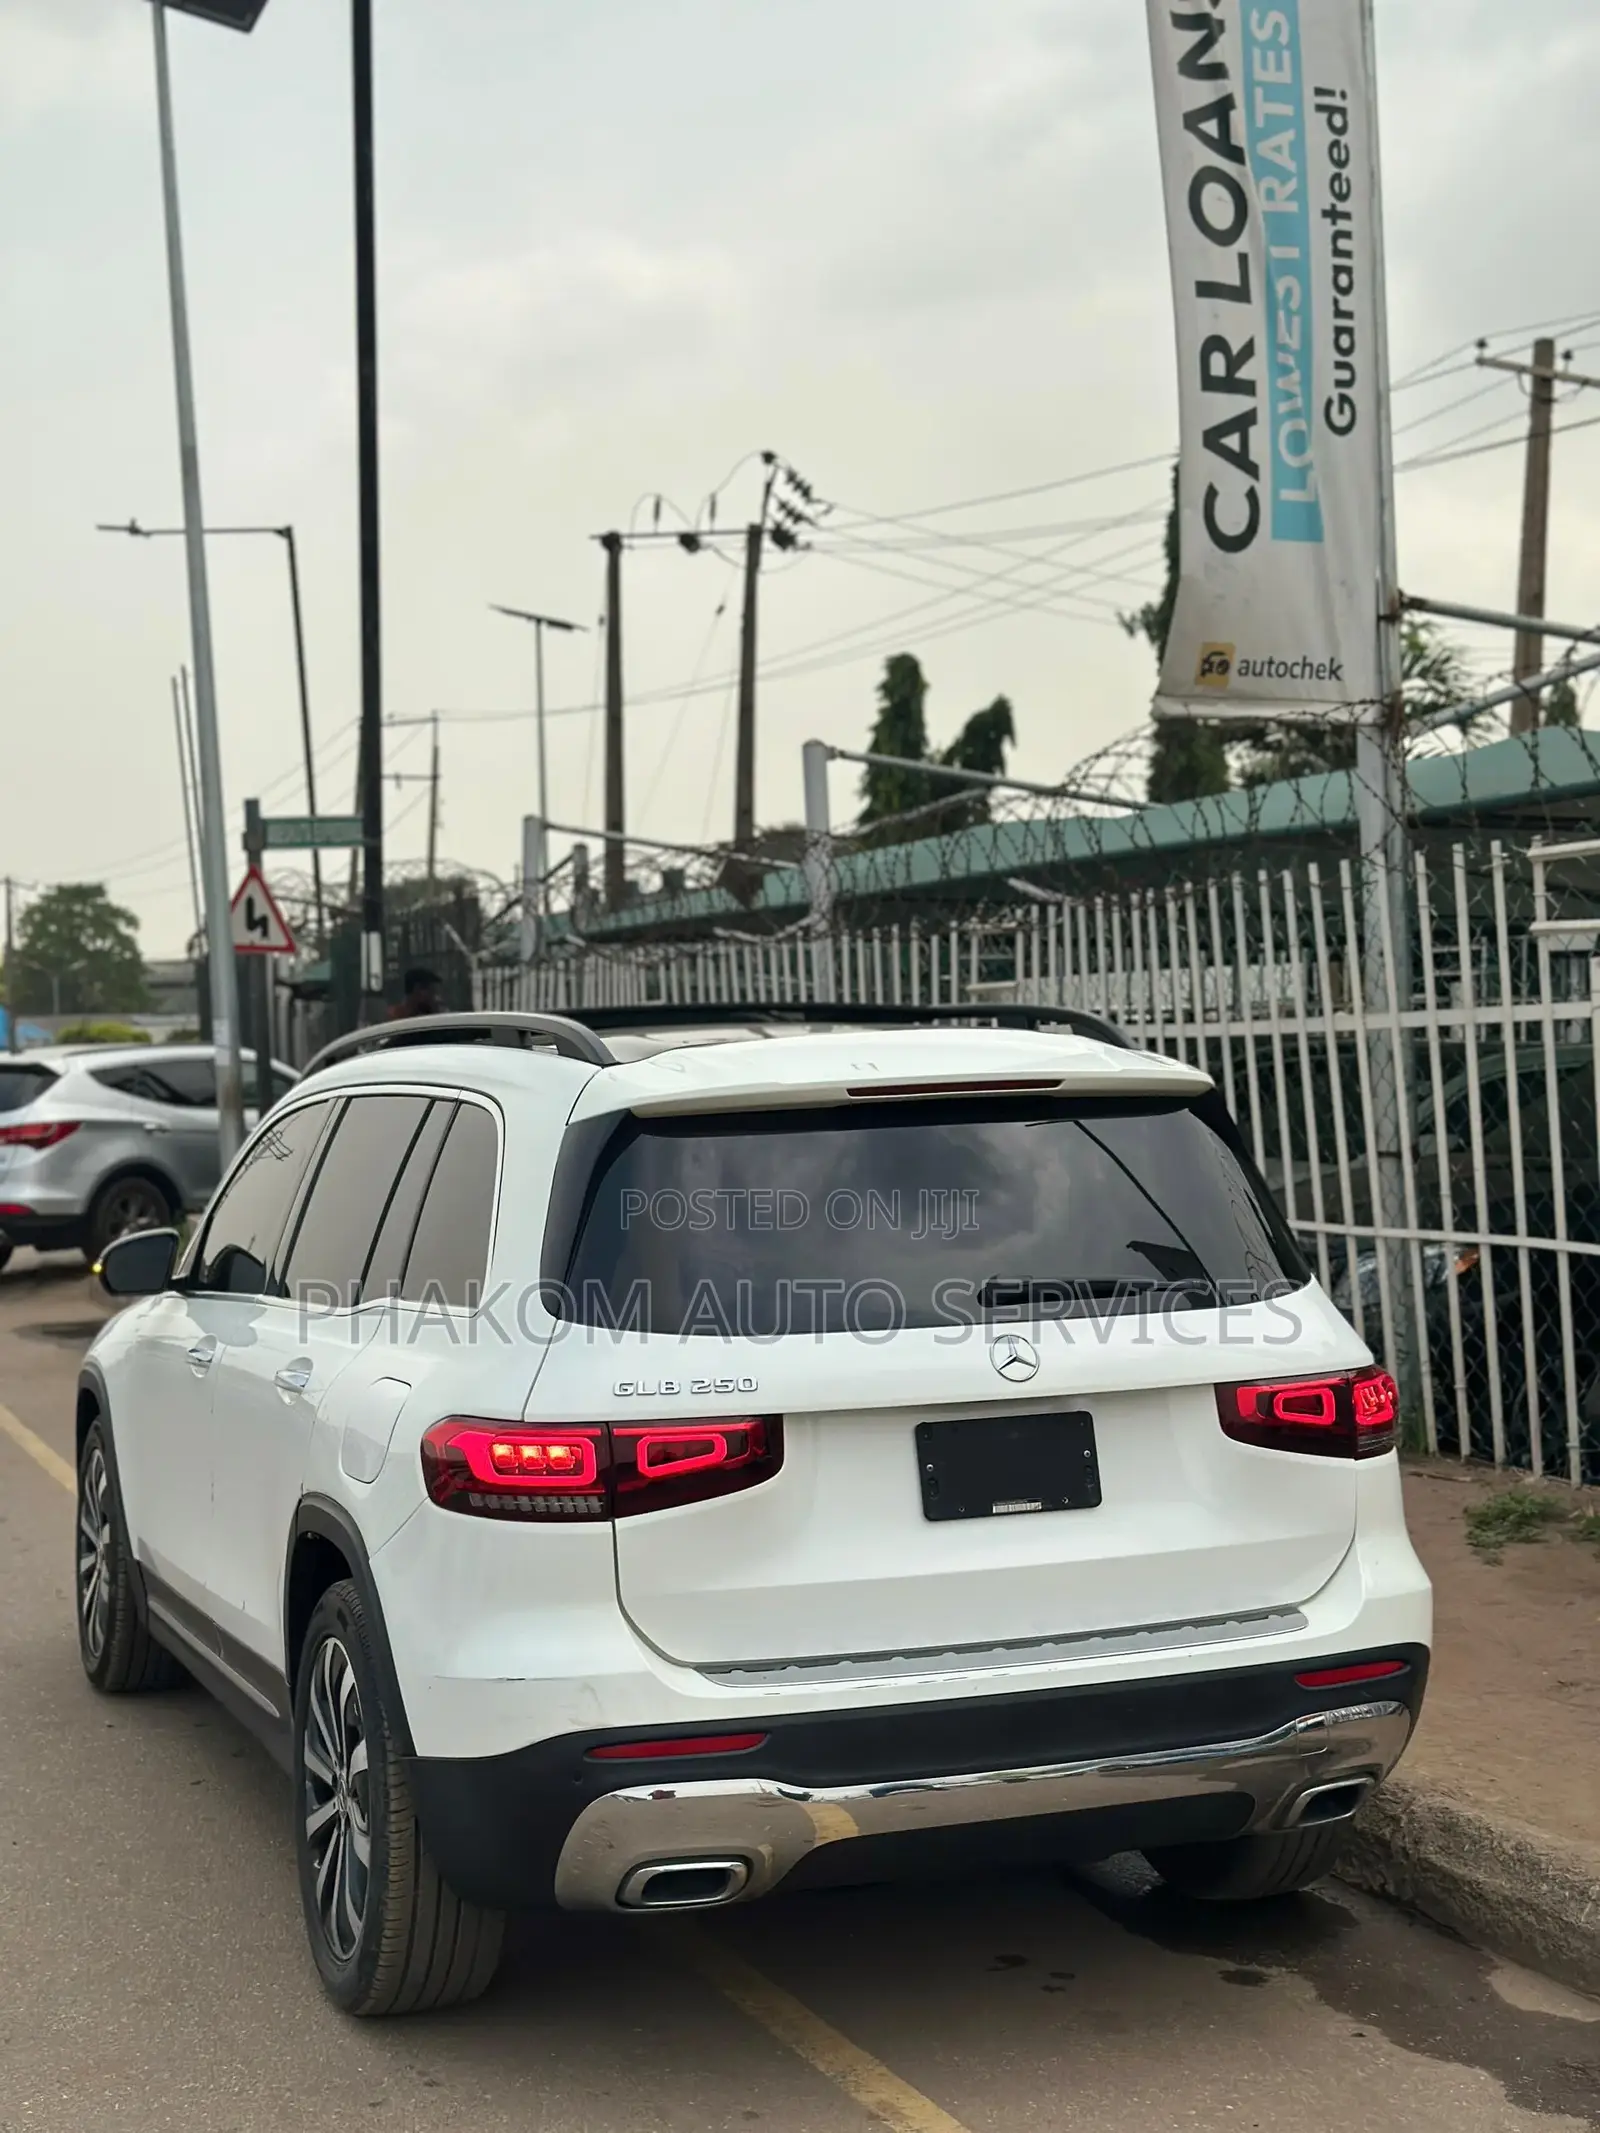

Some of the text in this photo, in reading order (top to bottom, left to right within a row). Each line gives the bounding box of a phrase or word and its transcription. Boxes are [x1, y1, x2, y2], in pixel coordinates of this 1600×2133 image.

[1250, 8, 1299, 213] RATES
[1169, 0, 1260, 553] CAR LOAN
[1313, 86, 1356, 437] Guaranteed!
[1237, 655, 1343, 682] autochek
[613, 1375, 758, 1397] GLB 250
